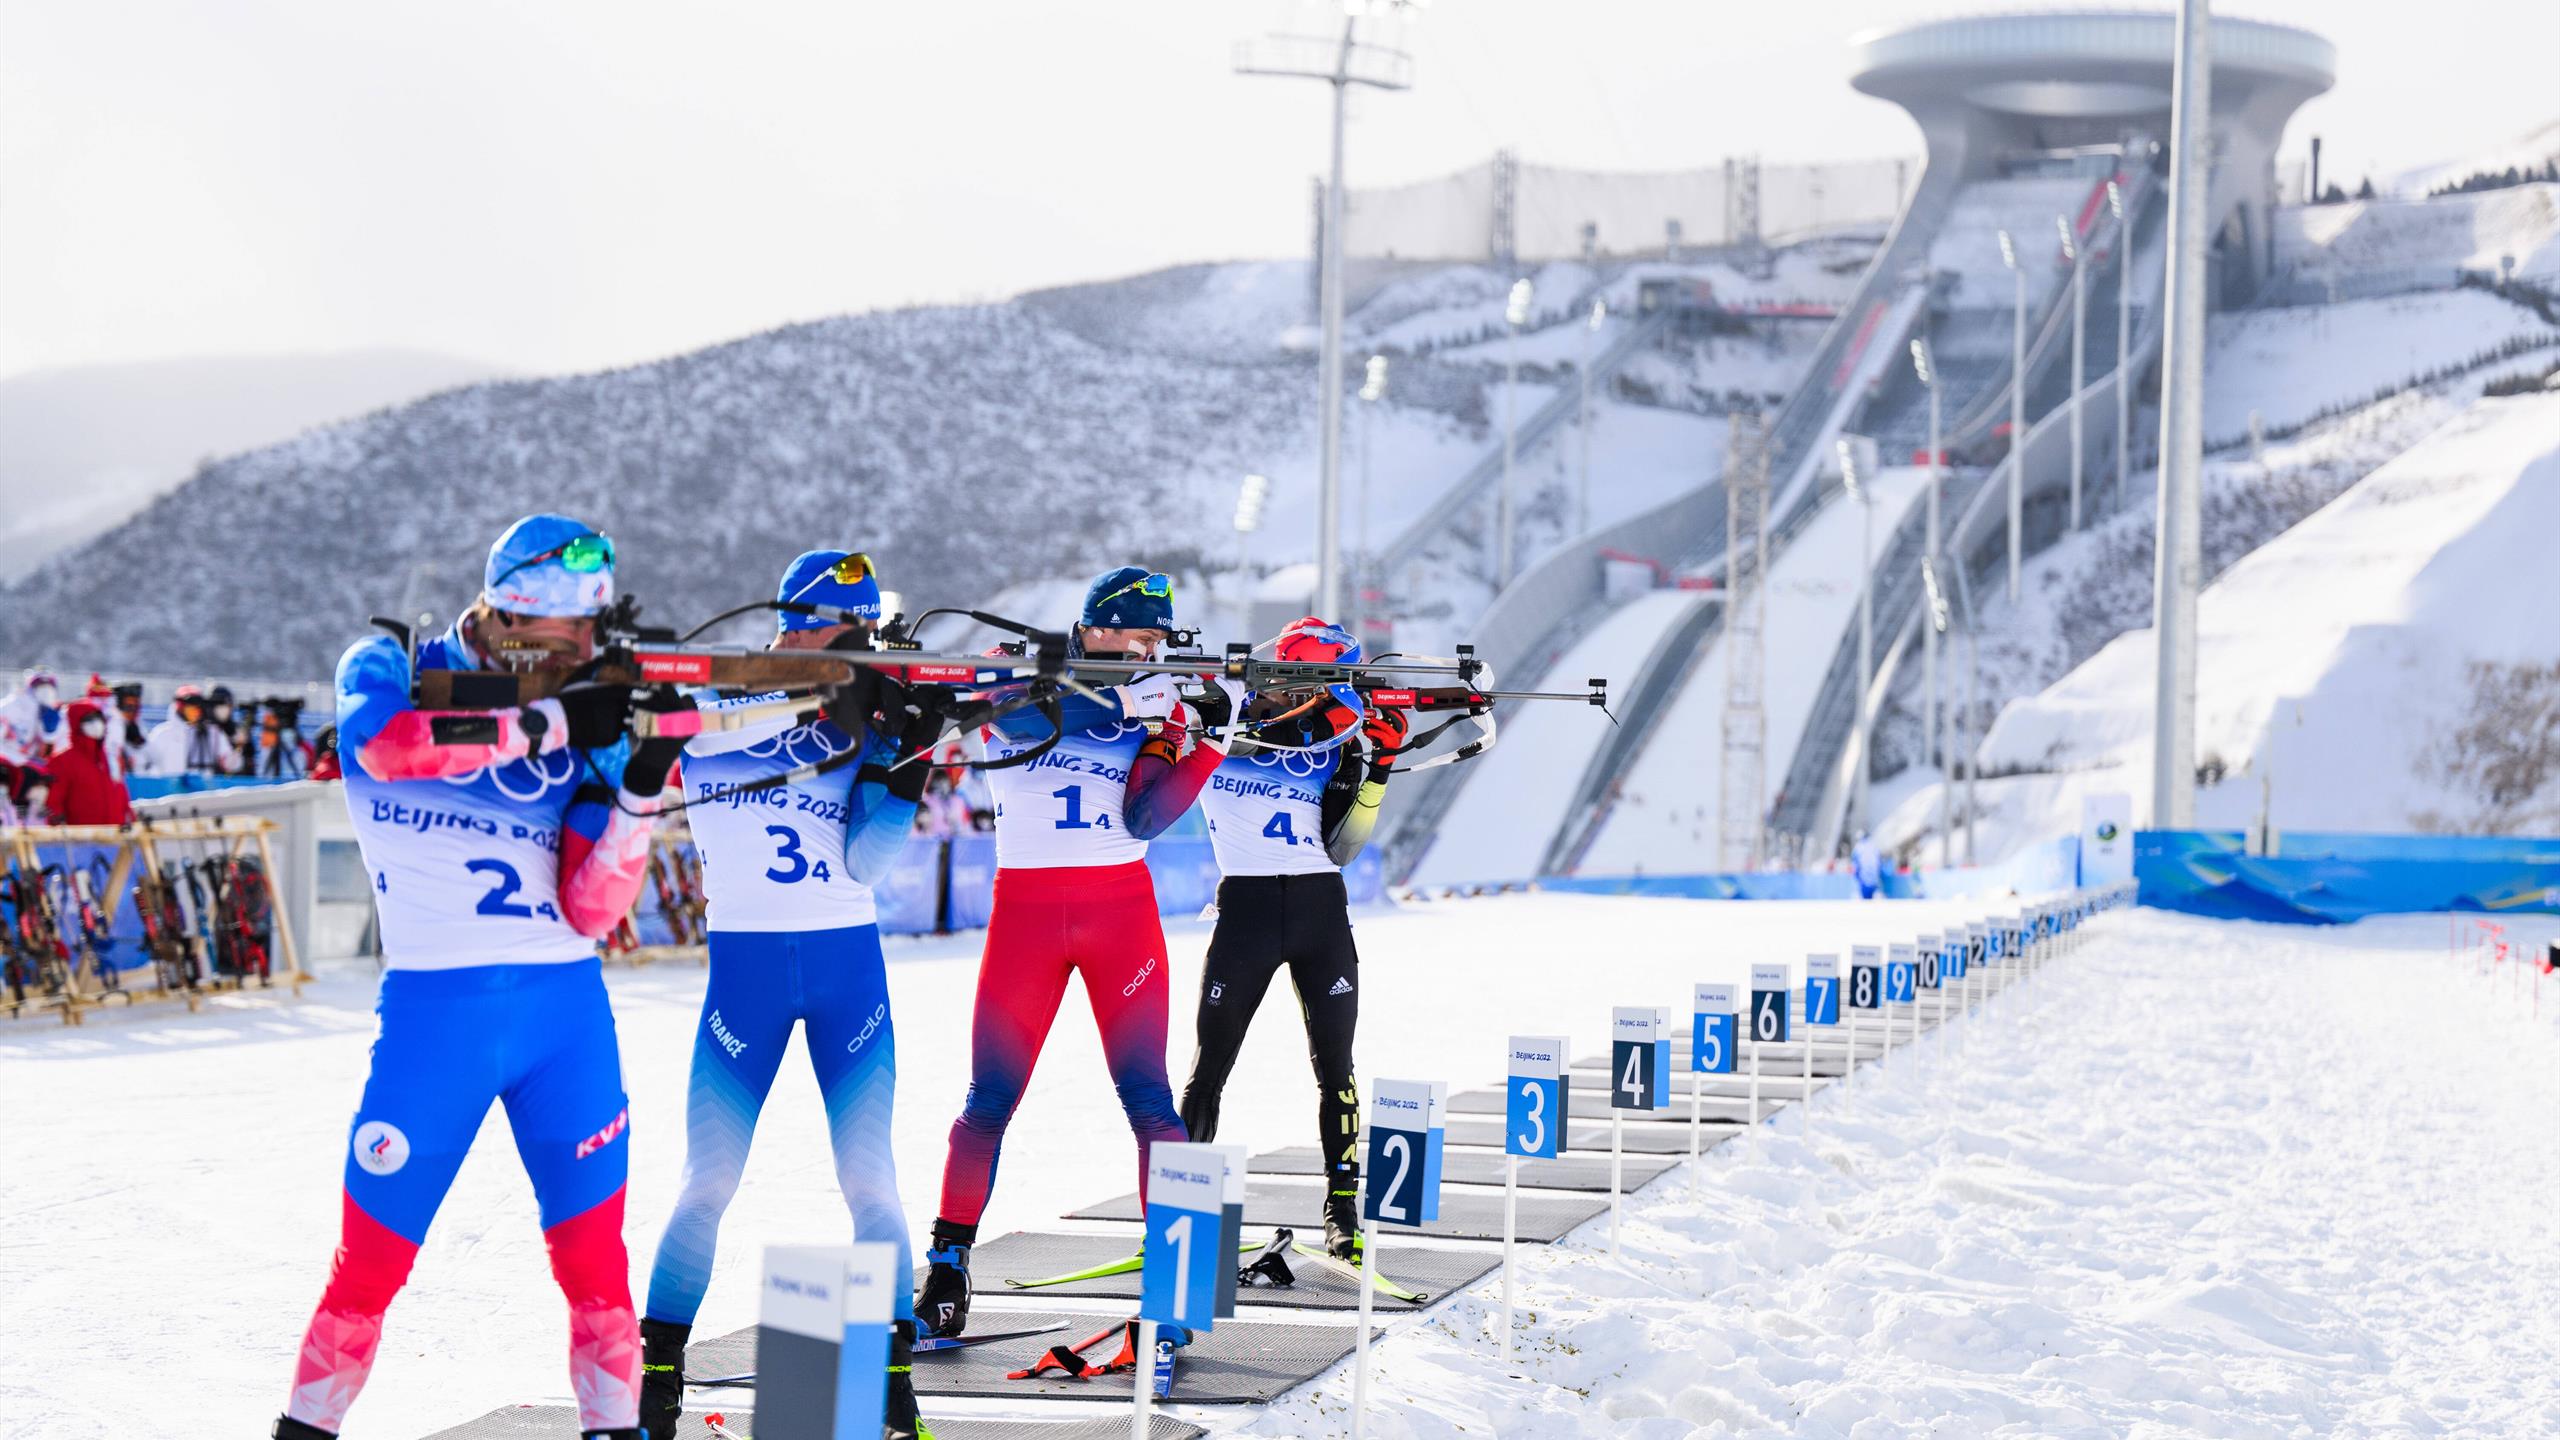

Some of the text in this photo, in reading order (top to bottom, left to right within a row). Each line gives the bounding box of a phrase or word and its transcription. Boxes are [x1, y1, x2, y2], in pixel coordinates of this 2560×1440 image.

[920, 667, 967, 677] BEIJING 2022
[1088, 762, 1129, 784] 202
[1212, 774, 1282, 800] BEIJING
[699, 783, 849, 824] BEIJING 2022
[1052, 784, 1112, 829] 1 4
[1262, 811, 1298, 845] 4
[765, 825, 831, 884] 3 4
[465, 858, 532, 918] 2
[1123, 958, 1155, 997] odlo
[1856, 966, 1872, 1007] 8
[1892, 963, 1907, 1000] 9
[1919, 951, 1938, 988] 10
[1210, 986, 1221, 998] D
[1329, 985, 1353, 996] adidas
[1813, 979, 1829, 1022] 7
[708, 1010, 748, 1059] FRANCE
[847, 1003, 886, 1053] odlo
[1758, 992, 1777, 1041] 6
[1515, 1051, 1551, 1061] BEIJING 2022
[1702, 1016, 1721, 1070] 5
[1621, 1046, 1644, 1106] 4
[1379, 1097, 1401, 1109] BEIJING
[1402, 1101, 1418, 1109] 2022
[1518, 1082, 1545, 1154] 3
[1379, 1134, 1411, 1221] 2
[1164, 1215, 1193, 1322] 1
